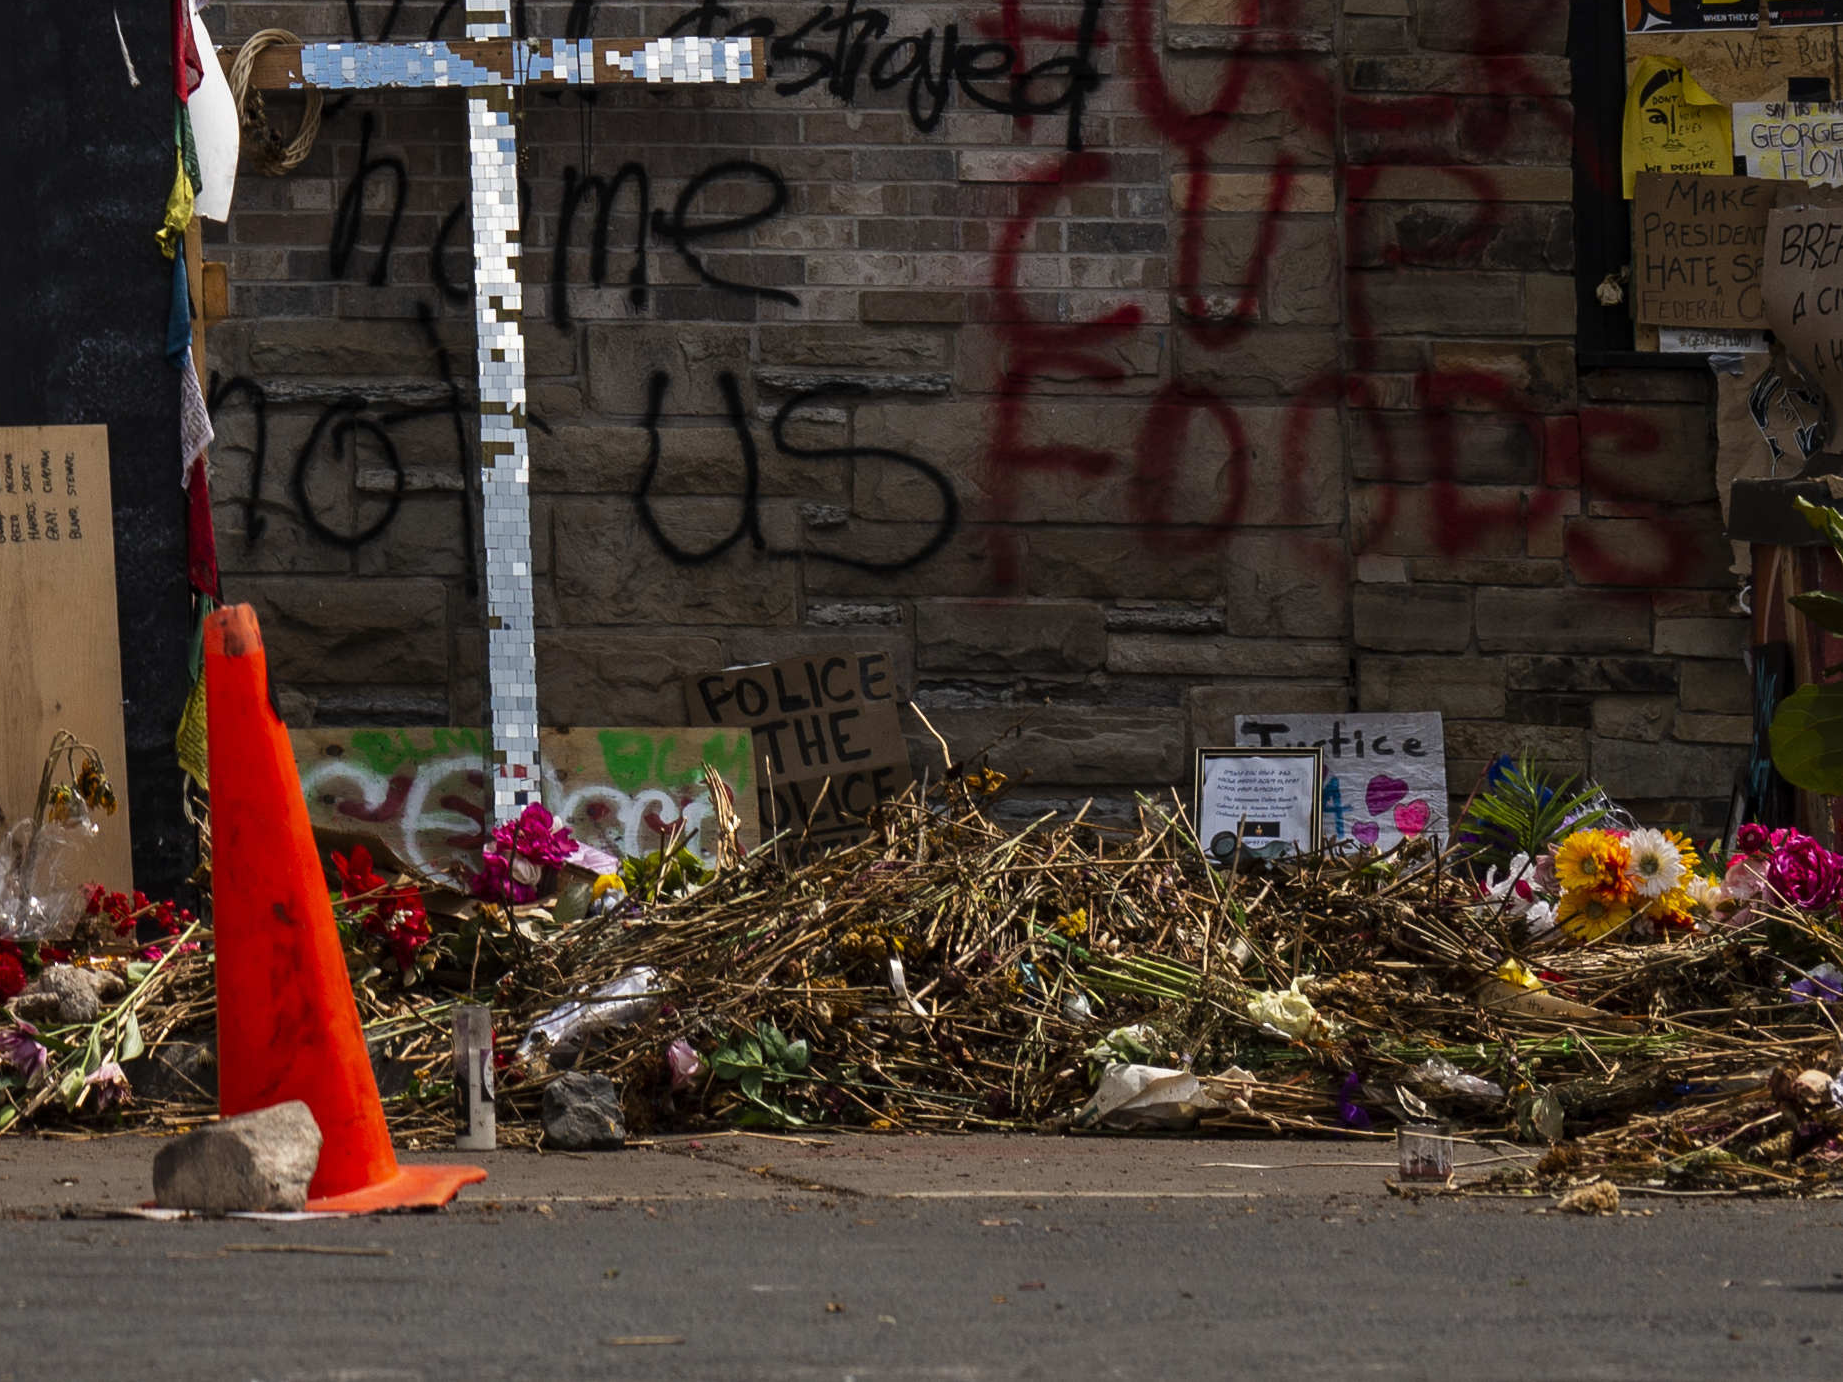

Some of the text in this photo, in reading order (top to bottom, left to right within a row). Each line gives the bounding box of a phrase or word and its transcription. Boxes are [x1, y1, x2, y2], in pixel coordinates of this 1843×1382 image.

[1728, 13, 1748, 22] THEY
[1725, 33, 1781, 69] WE
[1766, 103, 1786, 120] SAY
[1794, 102, 1810, 116] HIS
[1645, 163, 1663, 173] WE
[1670, 161, 1716, 172] DESERVE
[1781, 149, 1843, 180] FLOY
[1666, 179, 1761, 215] MAKE
[1646, 254, 1718, 289] HATE
[1643, 290, 1733, 320] FEDERAL
[751, 709, 872, 775] THE
[1241, 721, 1428, 759] Jtice
[756, 766, 896, 833] OLICE
